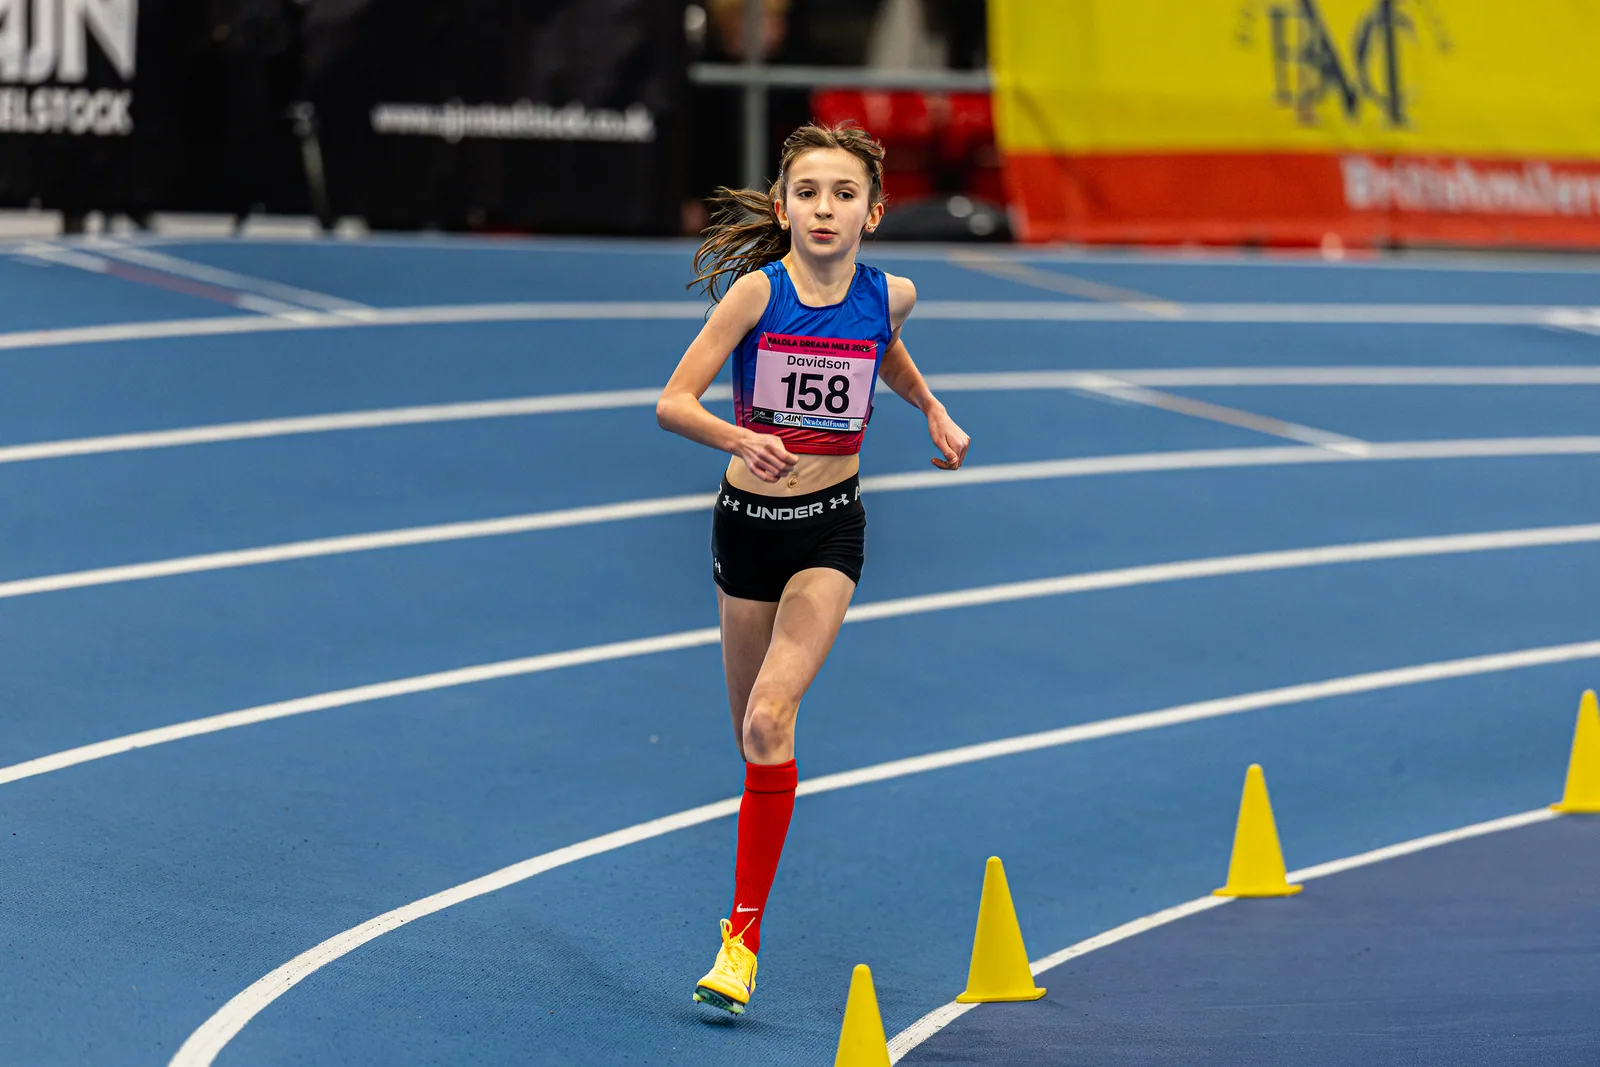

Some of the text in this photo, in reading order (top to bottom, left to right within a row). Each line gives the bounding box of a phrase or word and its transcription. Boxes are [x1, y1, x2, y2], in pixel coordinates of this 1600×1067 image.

[800, 340, 829, 349] DREAM
[831, 342, 849, 351] MILE
[787, 355, 850, 370] Davidson
[781, 372, 850, 414] 158
[746, 502, 824, 520] UNDER
